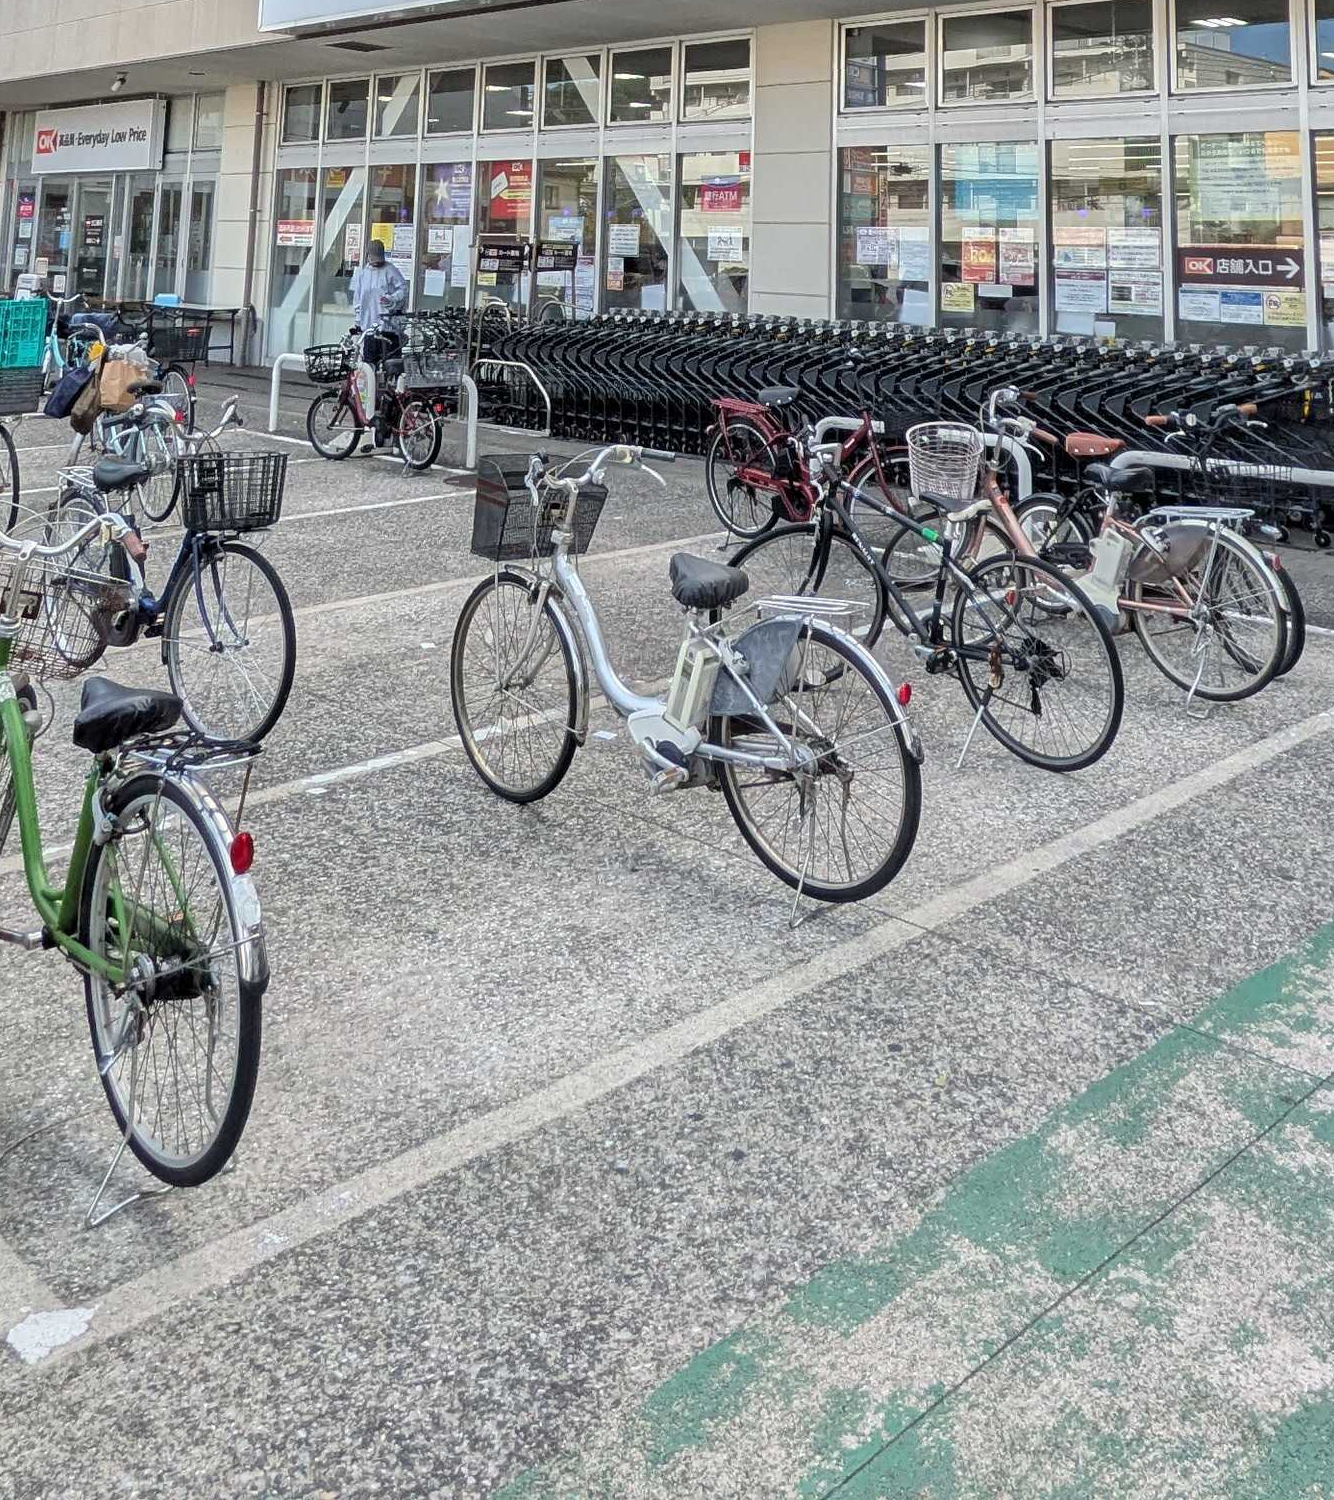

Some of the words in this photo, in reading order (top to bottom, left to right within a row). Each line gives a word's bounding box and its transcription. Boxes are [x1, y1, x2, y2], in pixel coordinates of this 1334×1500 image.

[38, 130, 58, 153] OK
[111, 130, 127, 145] Low
[128, 126, 147, 143] Price
[1188, 260, 1213, 273] OK
[1216, 259, 1273, 276] 店舗入口
